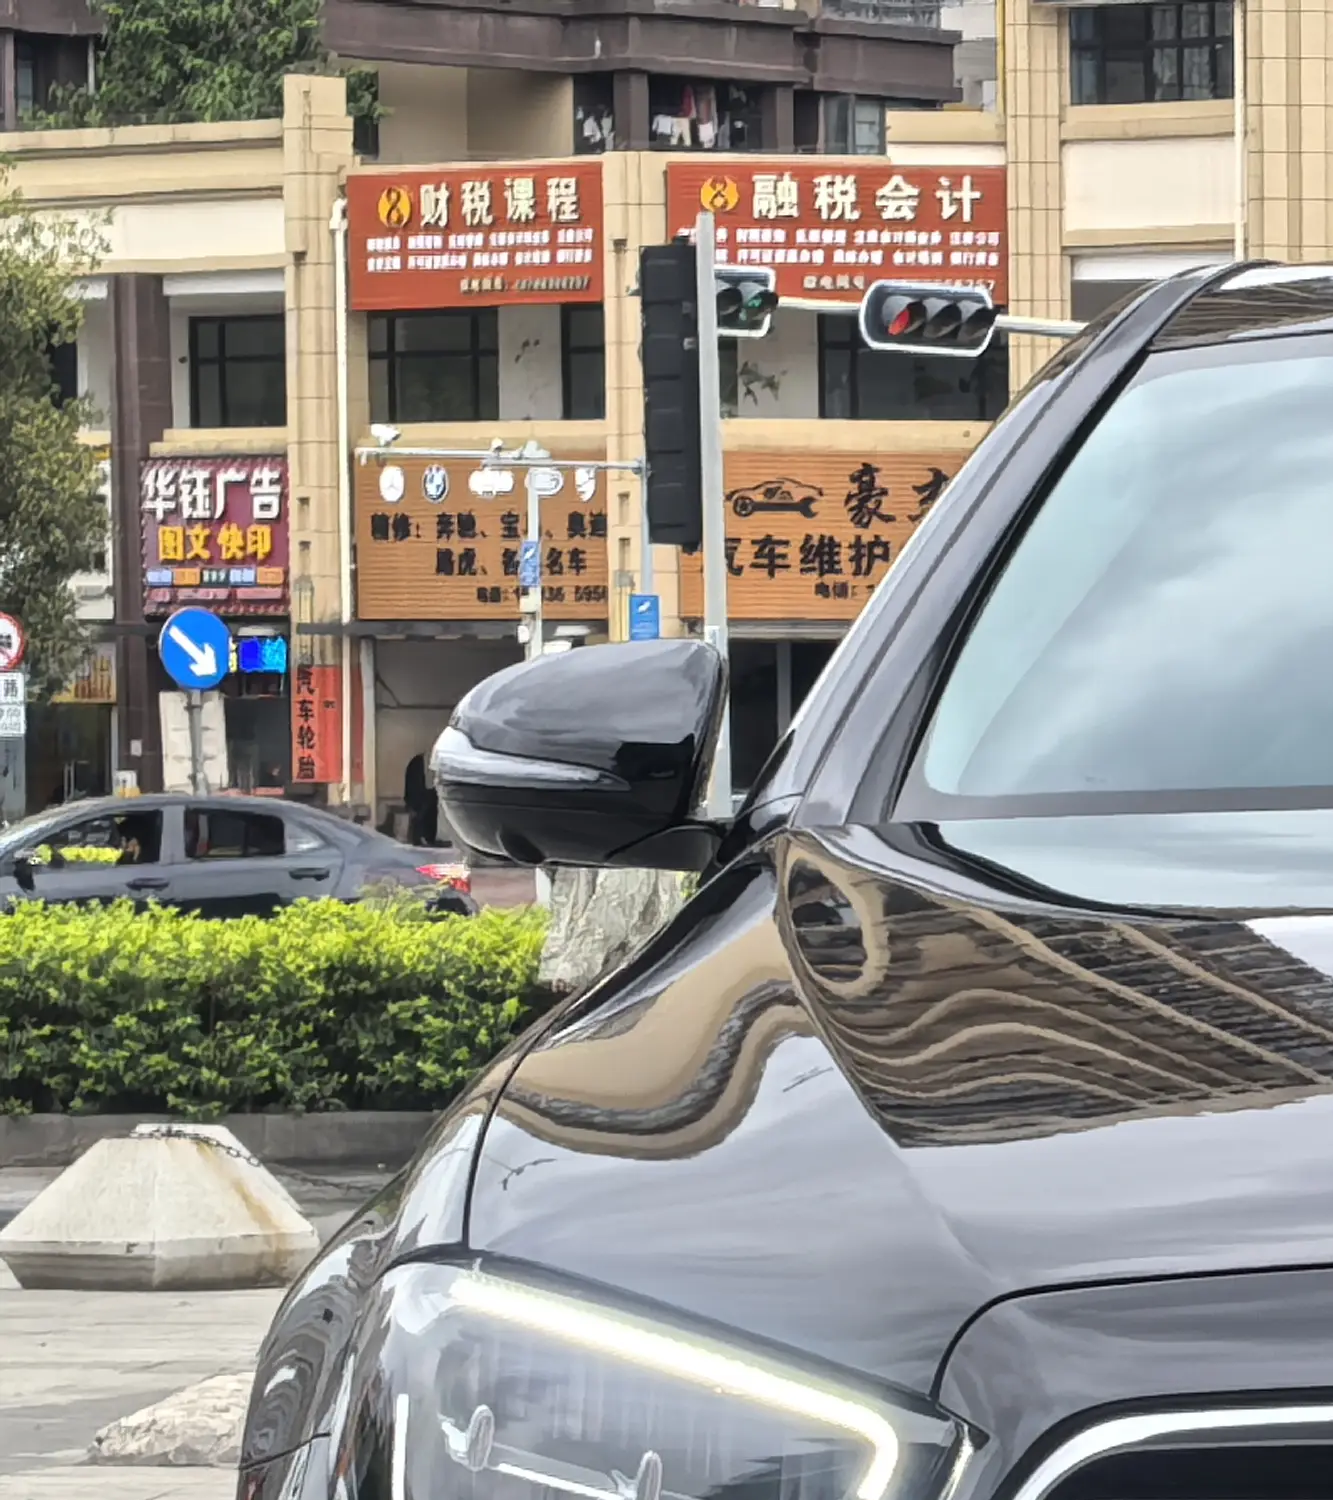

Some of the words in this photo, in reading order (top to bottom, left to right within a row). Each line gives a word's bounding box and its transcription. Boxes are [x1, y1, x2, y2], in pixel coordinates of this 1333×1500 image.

[419, 176, 580, 228] 财税课程
[752, 172, 981, 222] 融税会计
[142, 468, 283, 521] 华钰广告
[158, 523, 272, 561] 图文快印
